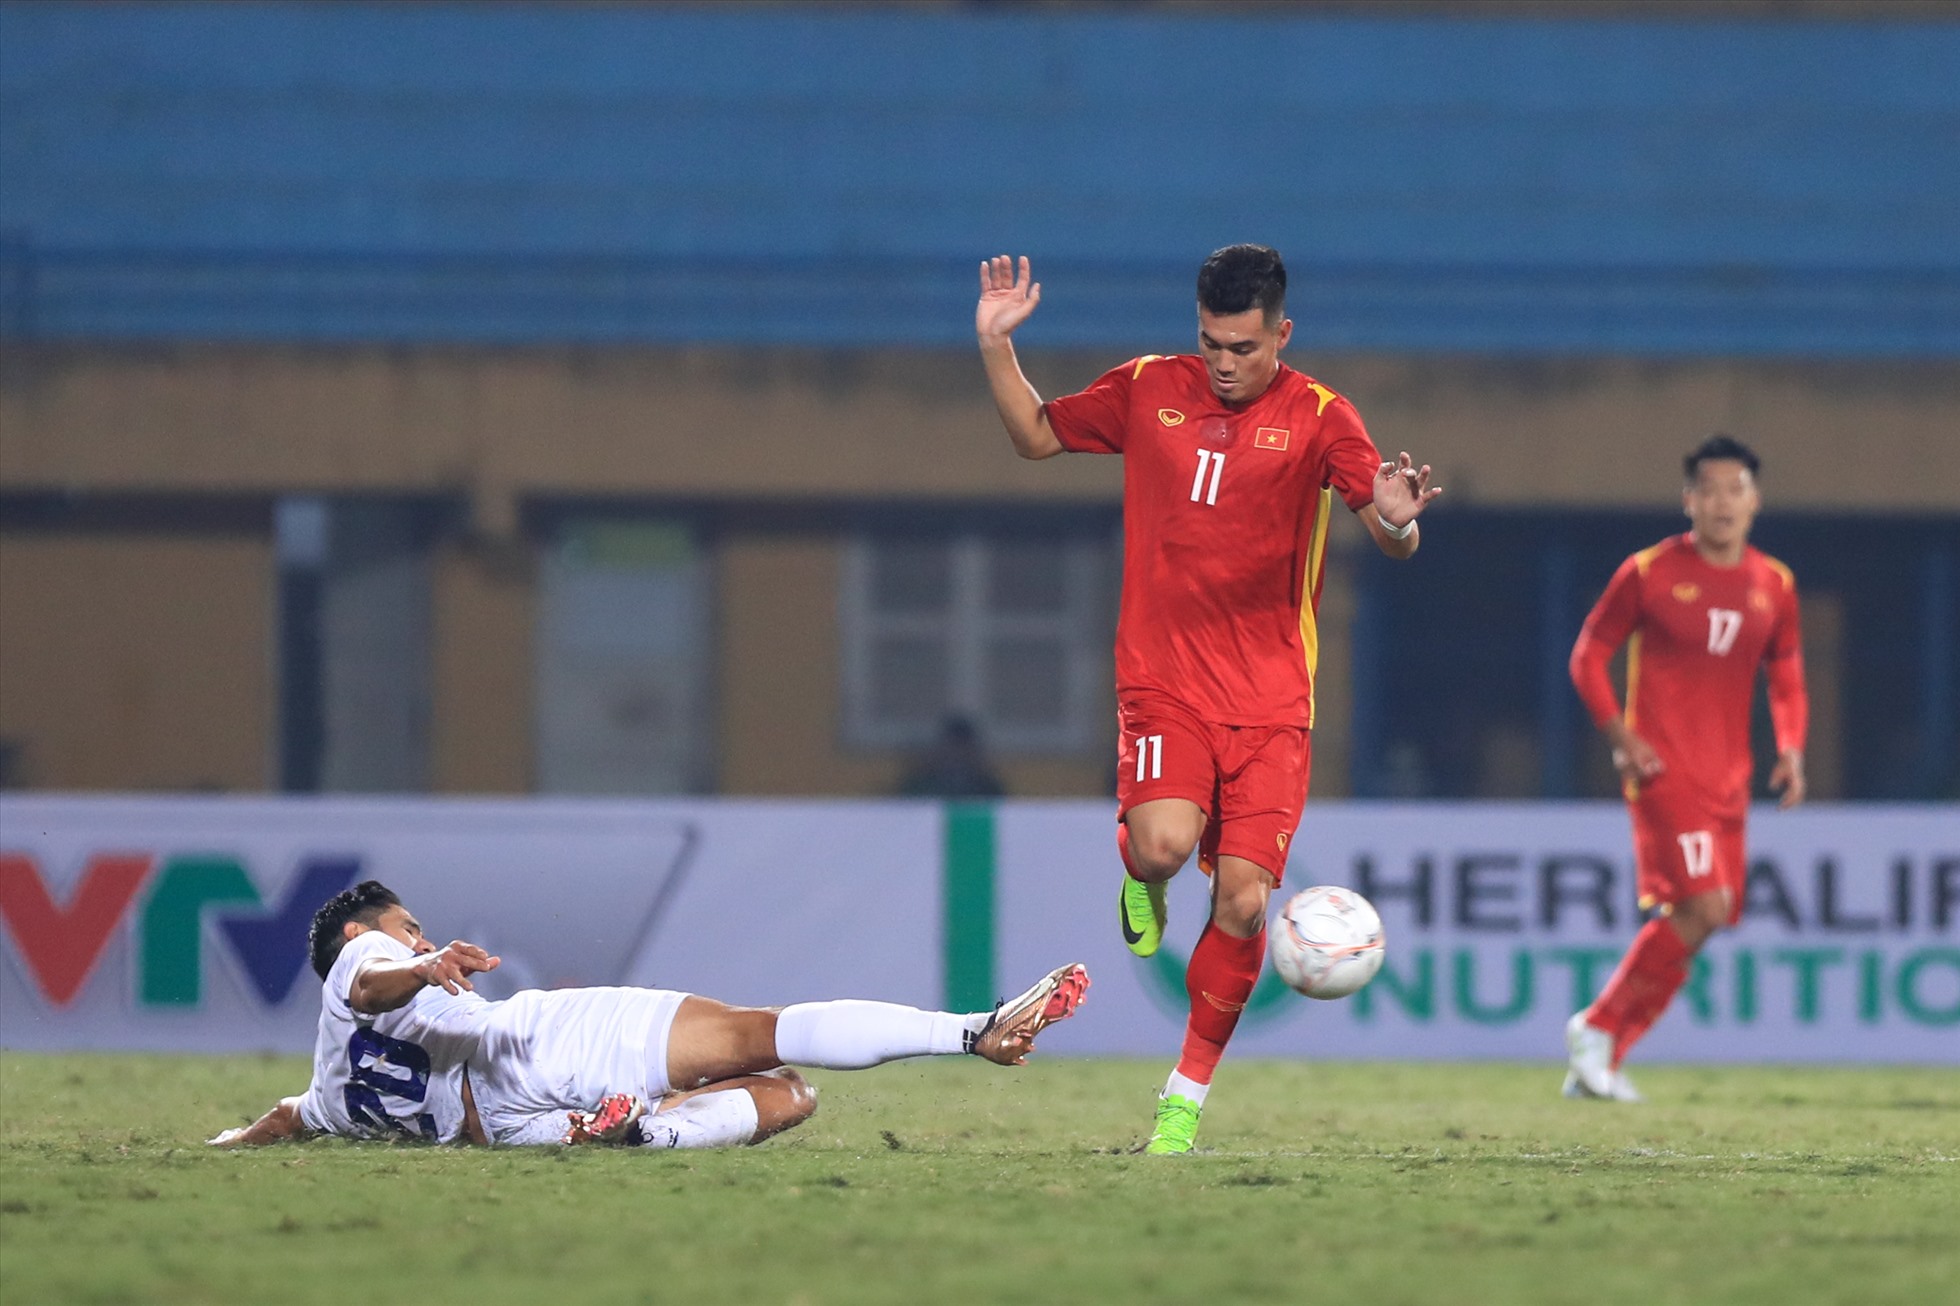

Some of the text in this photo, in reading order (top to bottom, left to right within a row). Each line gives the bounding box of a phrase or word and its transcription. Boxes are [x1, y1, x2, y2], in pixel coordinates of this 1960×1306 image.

[1190, 448, 1226, 506] 11
[1706, 608, 1743, 656] 17
[1135, 734, 1163, 783] 11
[1677, 830, 1714, 879] 17
[1354, 854, 1960, 932] HERALIF
[0, 854, 361, 1010] VTV
[344, 1026, 439, 1140] 20
